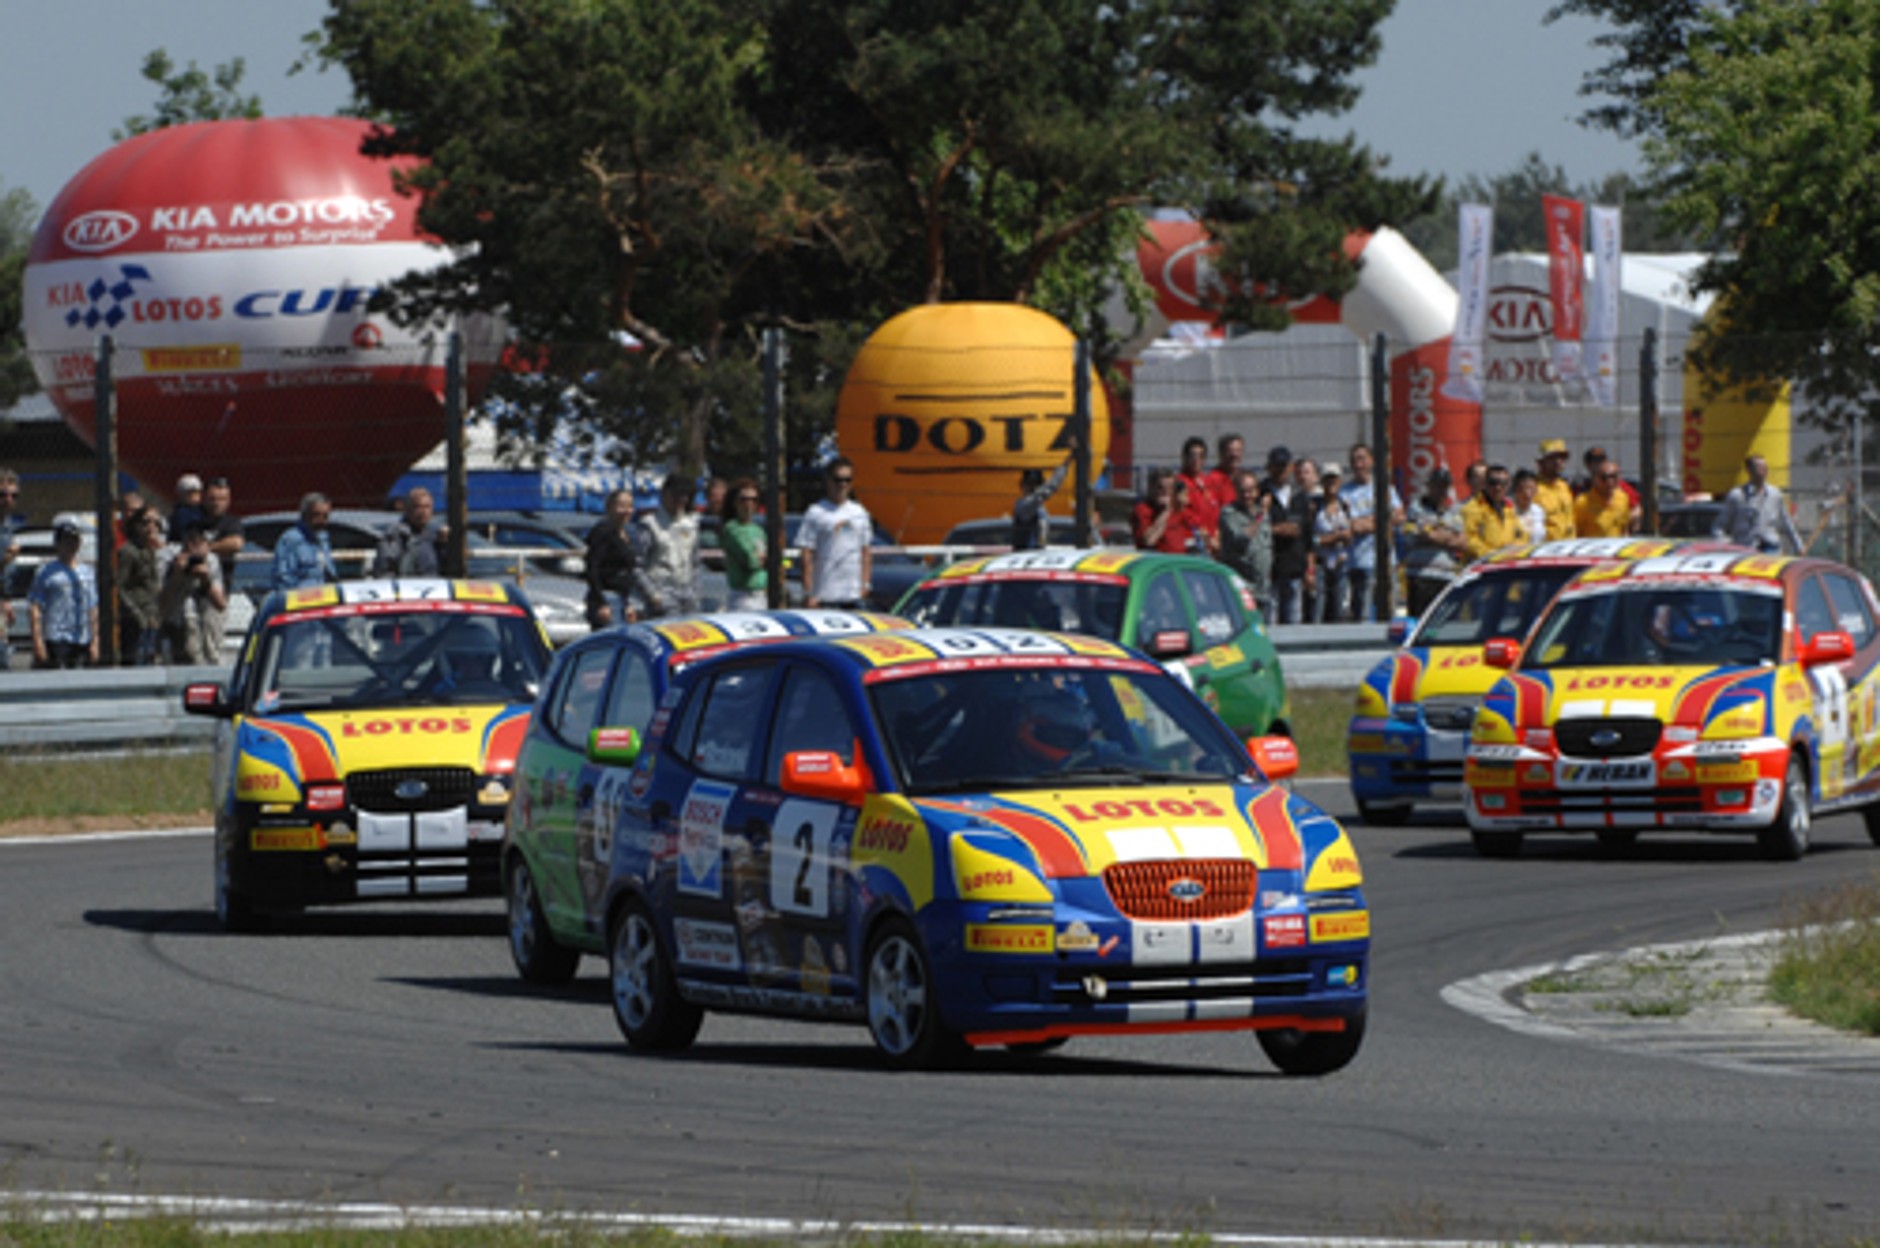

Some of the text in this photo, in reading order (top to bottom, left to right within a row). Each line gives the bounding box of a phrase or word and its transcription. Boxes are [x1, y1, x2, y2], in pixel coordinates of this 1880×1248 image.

[151, 198, 394, 231] KIA MOTORS
[75, 218, 123, 243] KIA
[166, 225, 376, 249] The Power to Surprise
[48, 282, 84, 306] KIA
[132, 296, 223, 322] LOTOS
[1567, 674, 1675, 690] LOTOS
[342, 718, 472, 738] LOTOS
[1062, 799, 1225, 823] LOTOS
[793, 821, 814, 907] 2
